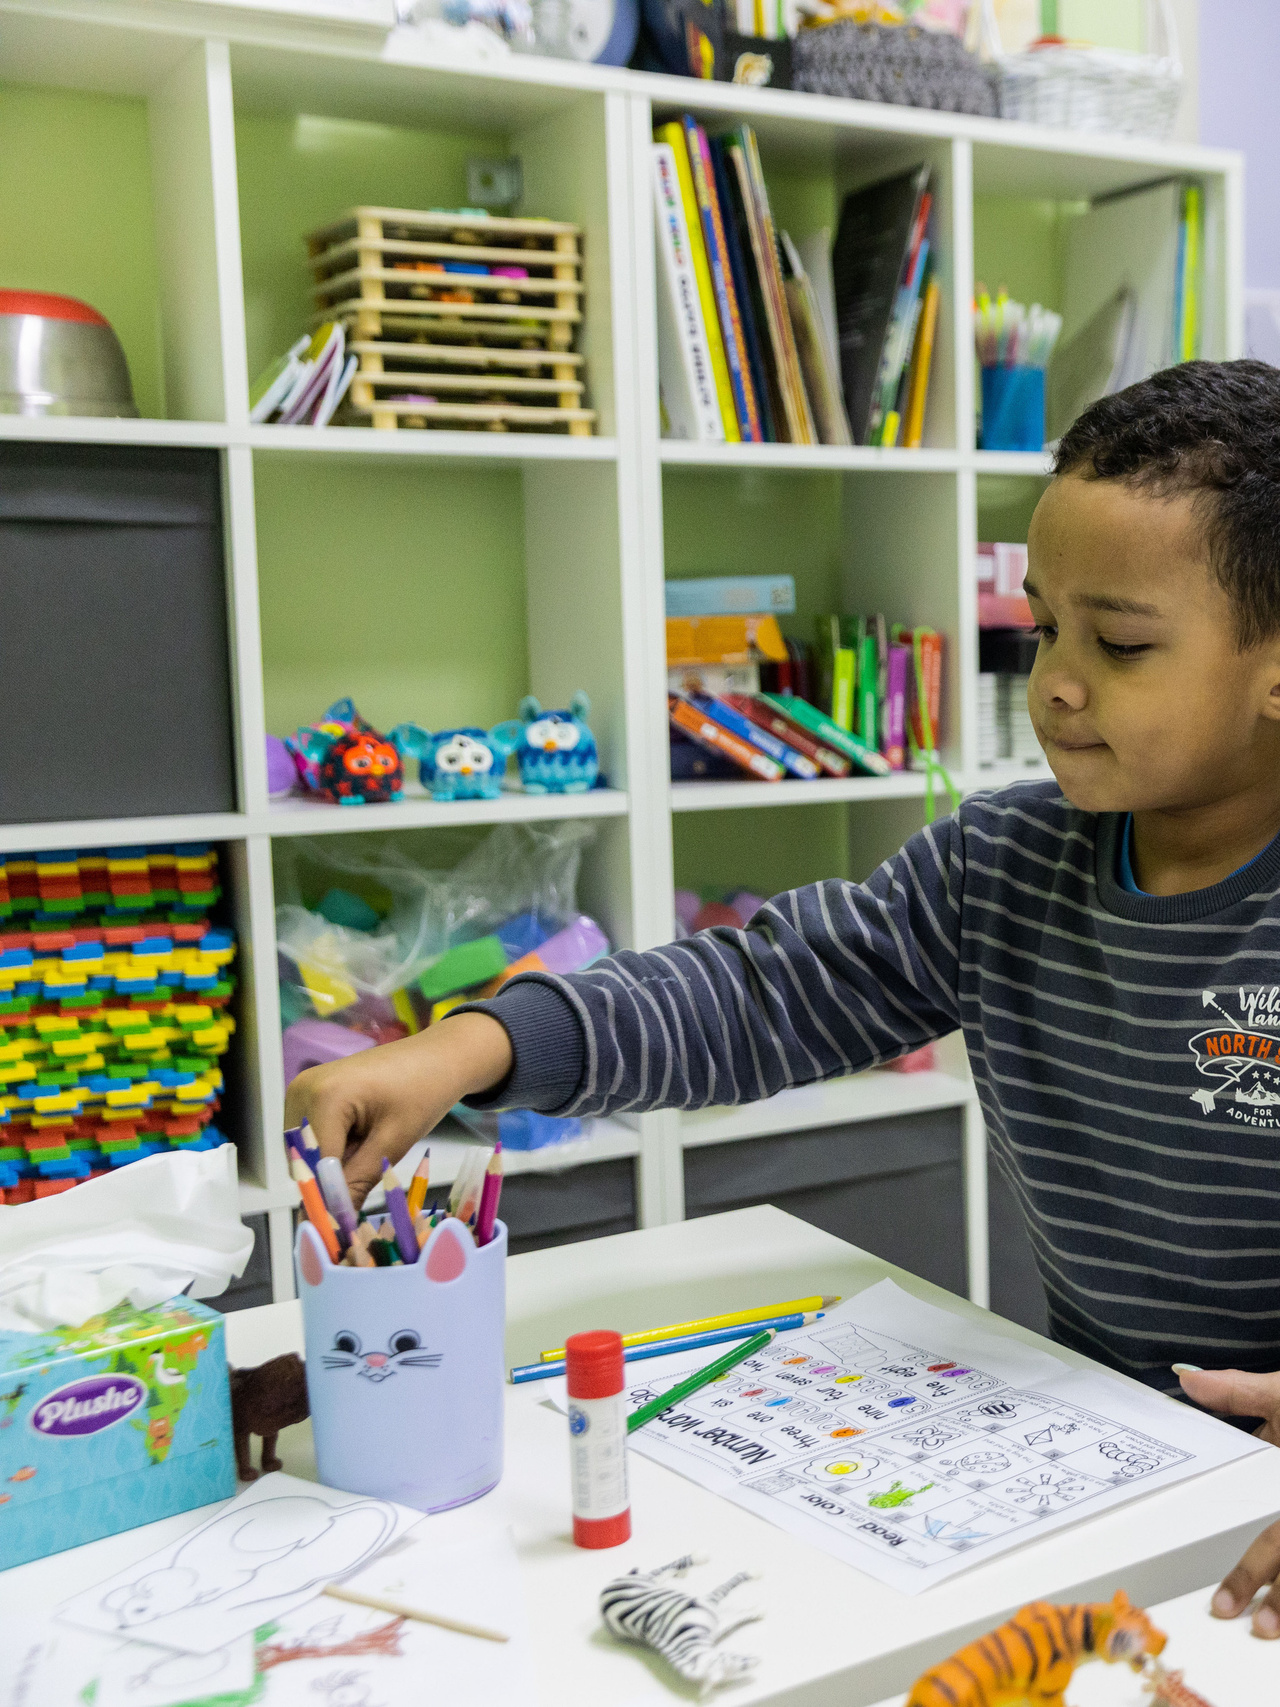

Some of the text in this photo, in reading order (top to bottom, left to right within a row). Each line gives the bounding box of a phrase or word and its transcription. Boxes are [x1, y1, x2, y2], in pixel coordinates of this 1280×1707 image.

[1205, 1034, 1272, 1058] NORTH
[1253, 1107, 1273, 1117] FOR
[742, 1359, 769, 1373] two
[877, 1363, 918, 1378] eight
[774, 1372, 813, 1386] seven
[815, 1387, 848, 1402] four
[926, 1381, 955, 1397] five
[711, 1398, 733, 1407] six
[746, 1411, 773, 1422] one
[857, 1404, 888, 1419] nine
[780, 1425, 819, 1448] three
[692, 1426, 776, 1464] Number
[800, 1494, 844, 1514] Color
[857, 1522, 906, 1546] Read
